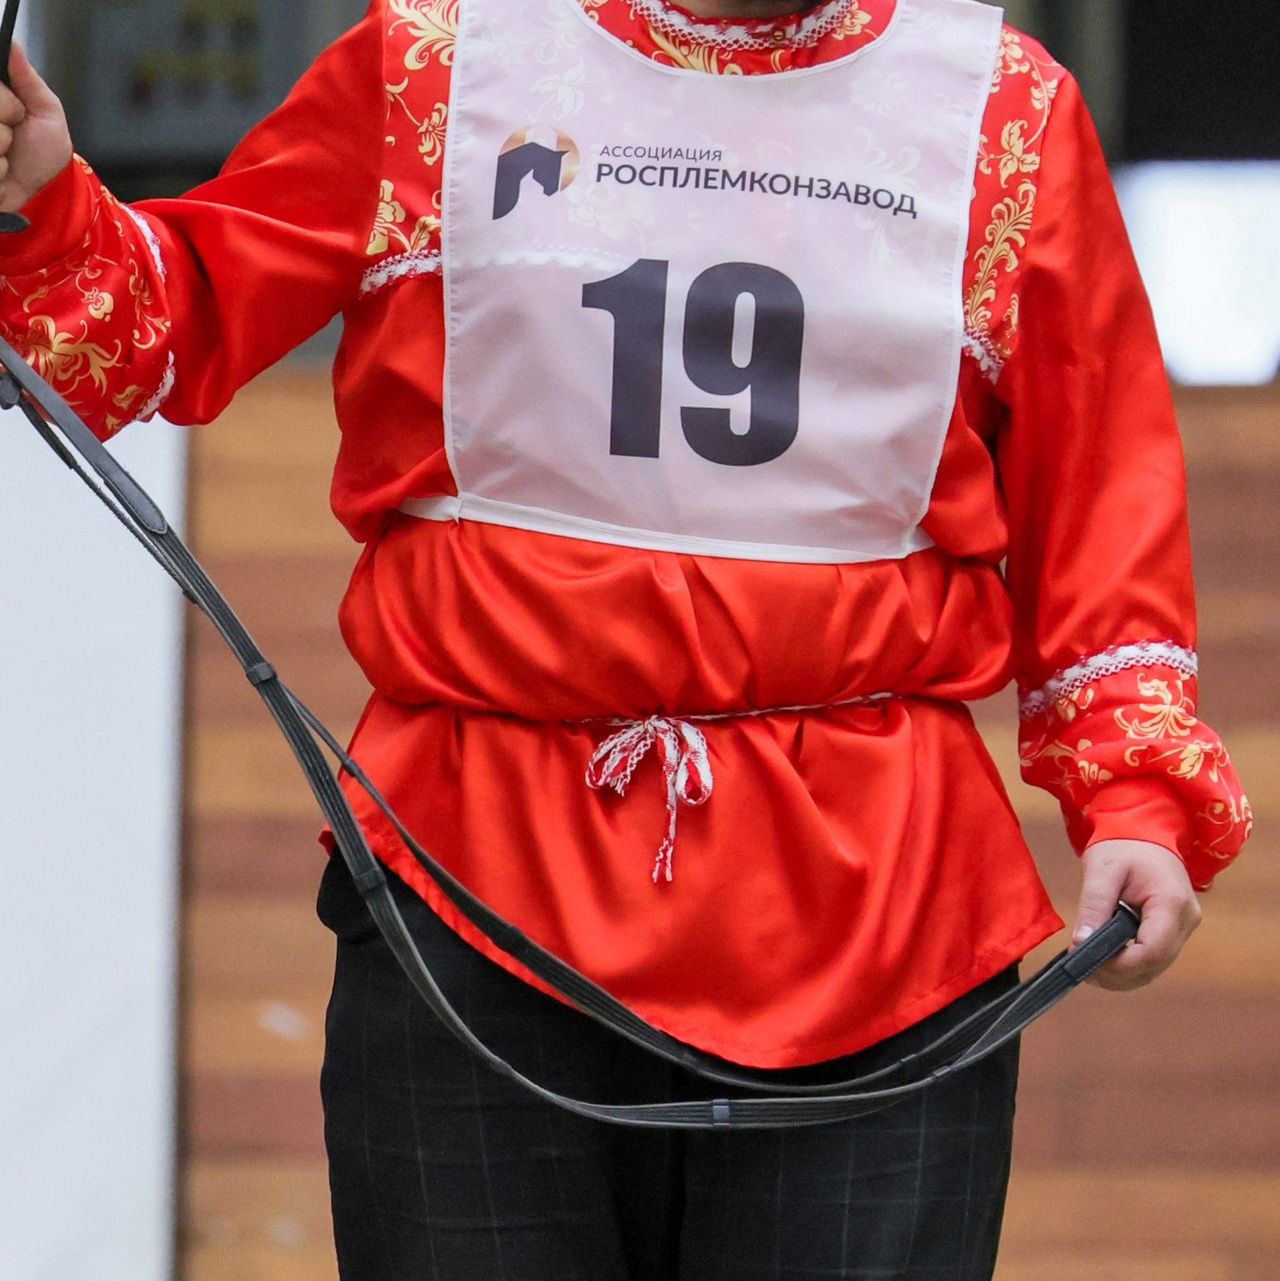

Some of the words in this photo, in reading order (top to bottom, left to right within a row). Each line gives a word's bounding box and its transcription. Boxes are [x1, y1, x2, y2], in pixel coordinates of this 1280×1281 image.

[600, 145, 722, 162] АССОЦИАЦИЯ
[595, 163, 917, 219] РОСПЛЕМКОНЗАВОД
[581, 258, 805, 467] 19
